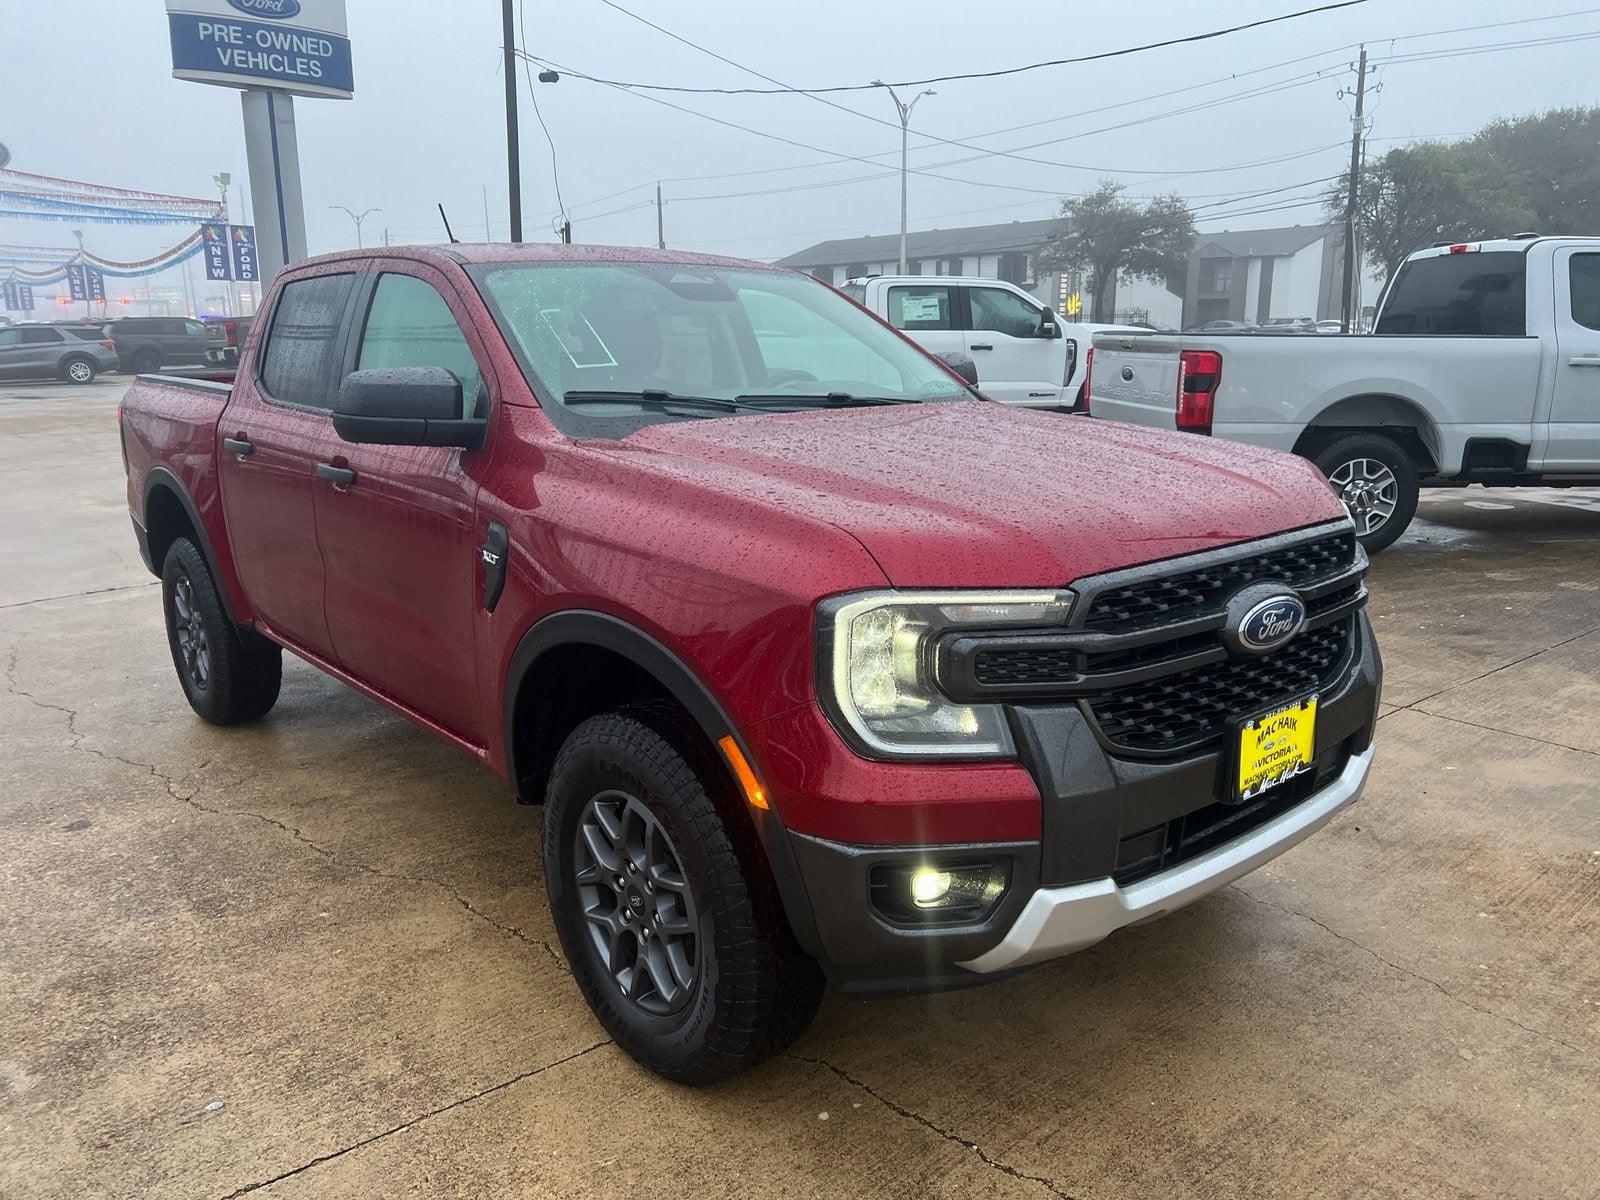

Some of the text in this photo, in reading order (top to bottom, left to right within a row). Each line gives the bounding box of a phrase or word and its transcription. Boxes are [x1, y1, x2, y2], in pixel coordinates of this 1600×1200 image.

[217, 47, 322, 78] VEHICLES
[211, 246, 225, 278] NEW
[240, 247, 252, 279] FORD
[72, 278, 83, 299] NEW
[1093, 382, 1171, 402] SUPER DUTY
[482, 549, 500, 565] XLT
[1258, 607, 1294, 640] Ford
[1256, 720, 1277, 749] MAC
[1277, 716, 1298, 732] HAIK
[1257, 745, 1292, 768] VICTORIA
